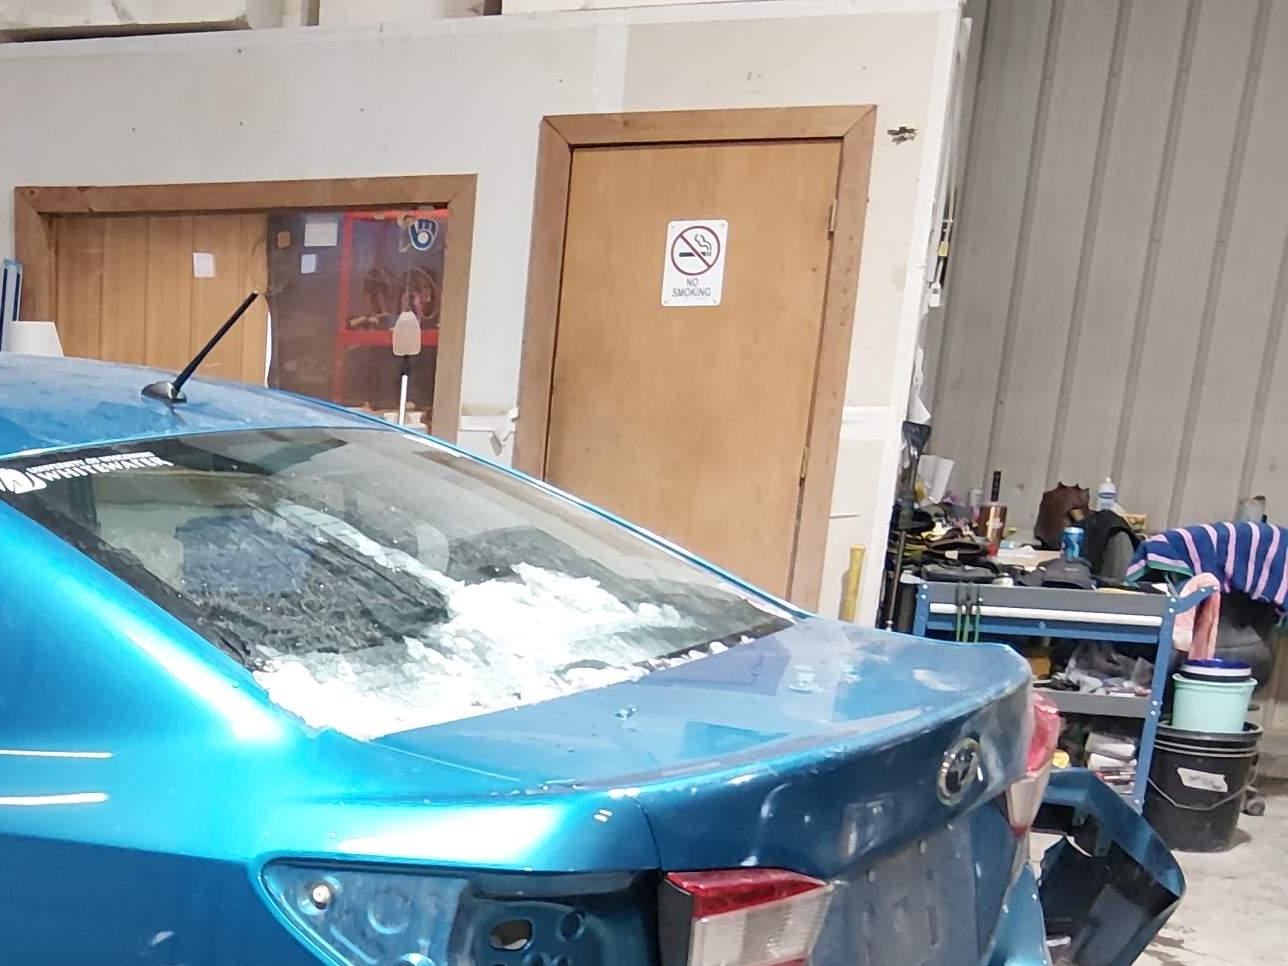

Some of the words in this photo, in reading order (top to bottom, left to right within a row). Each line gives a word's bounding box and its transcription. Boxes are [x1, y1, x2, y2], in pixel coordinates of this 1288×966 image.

[686, 277, 699, 287] NO
[672, 287, 711, 297] SMOKING
[36, 456, 174, 482] WHITEWATER
